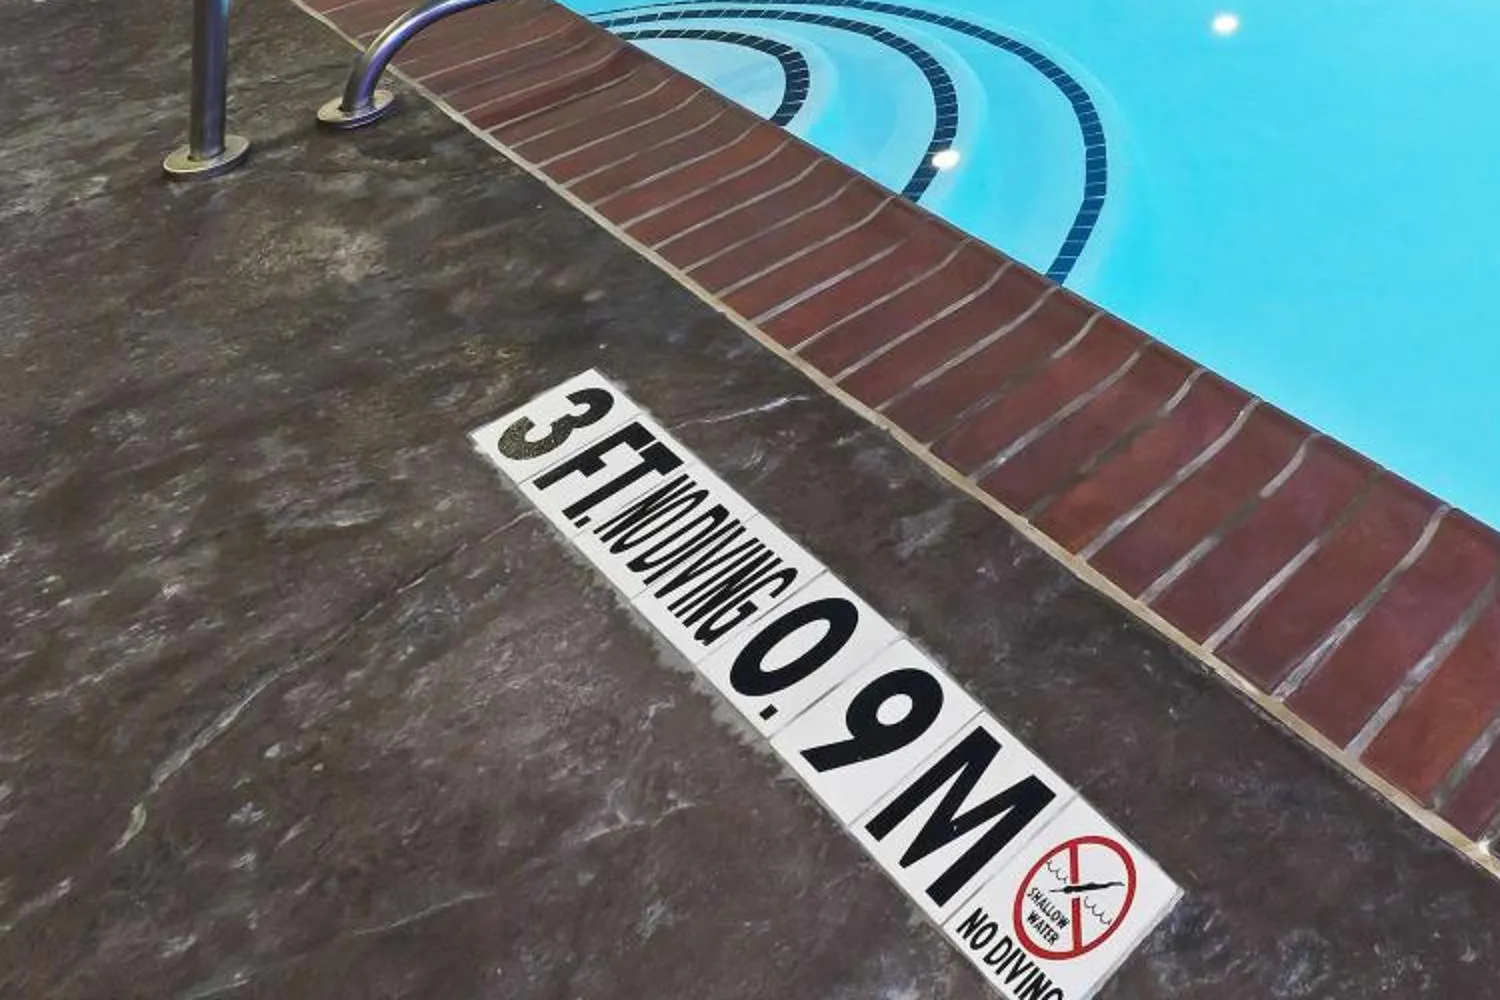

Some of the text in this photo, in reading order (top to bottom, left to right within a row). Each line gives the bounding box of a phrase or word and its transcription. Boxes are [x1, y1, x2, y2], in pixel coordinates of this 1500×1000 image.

[498, 387, 614, 461] 3
[593, 473, 709, 554] NO
[626, 503, 798, 646] DIVING
[955, 907, 998, 951] NO
[1025, 911, 1060, 947] WATER
[1027, 886, 1071, 930] SHALLOW
